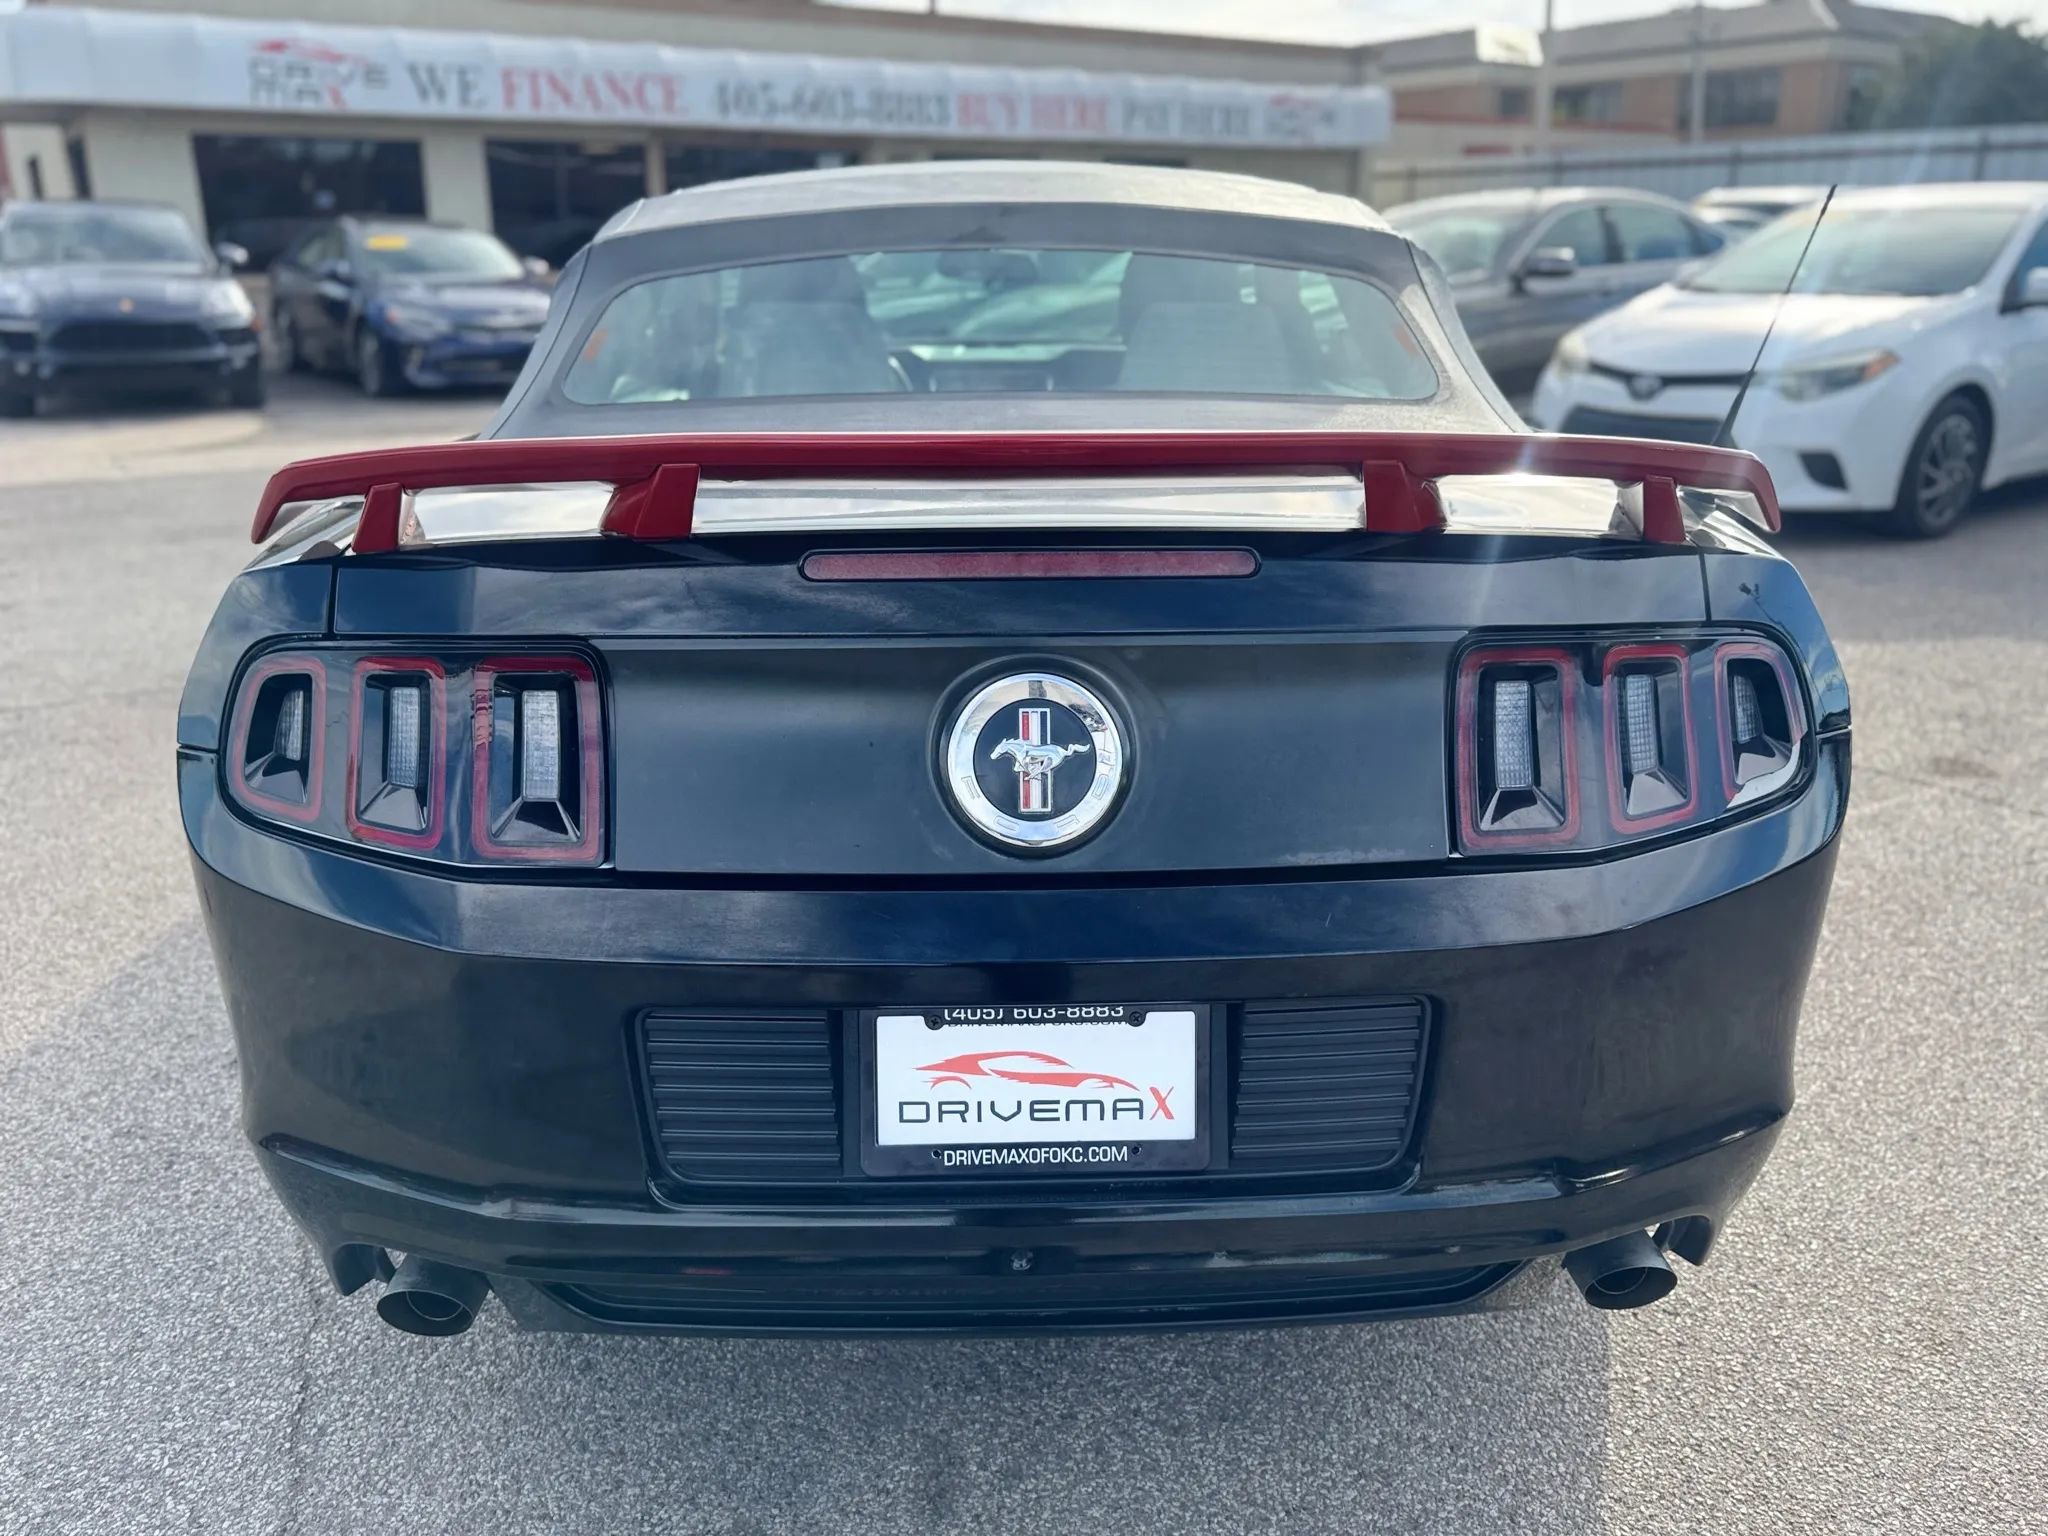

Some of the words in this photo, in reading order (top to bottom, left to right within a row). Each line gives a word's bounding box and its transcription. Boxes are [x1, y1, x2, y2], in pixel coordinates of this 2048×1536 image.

[406, 62, 487, 108] WE
[501, 68, 687, 116] FINANCE
[944, 1008, 1003, 1021] (405)
[898, 1086, 1175, 1123] DRIVEMAX
[943, 1145, 1129, 1167] DRIVEMAXOFOKC.COM
